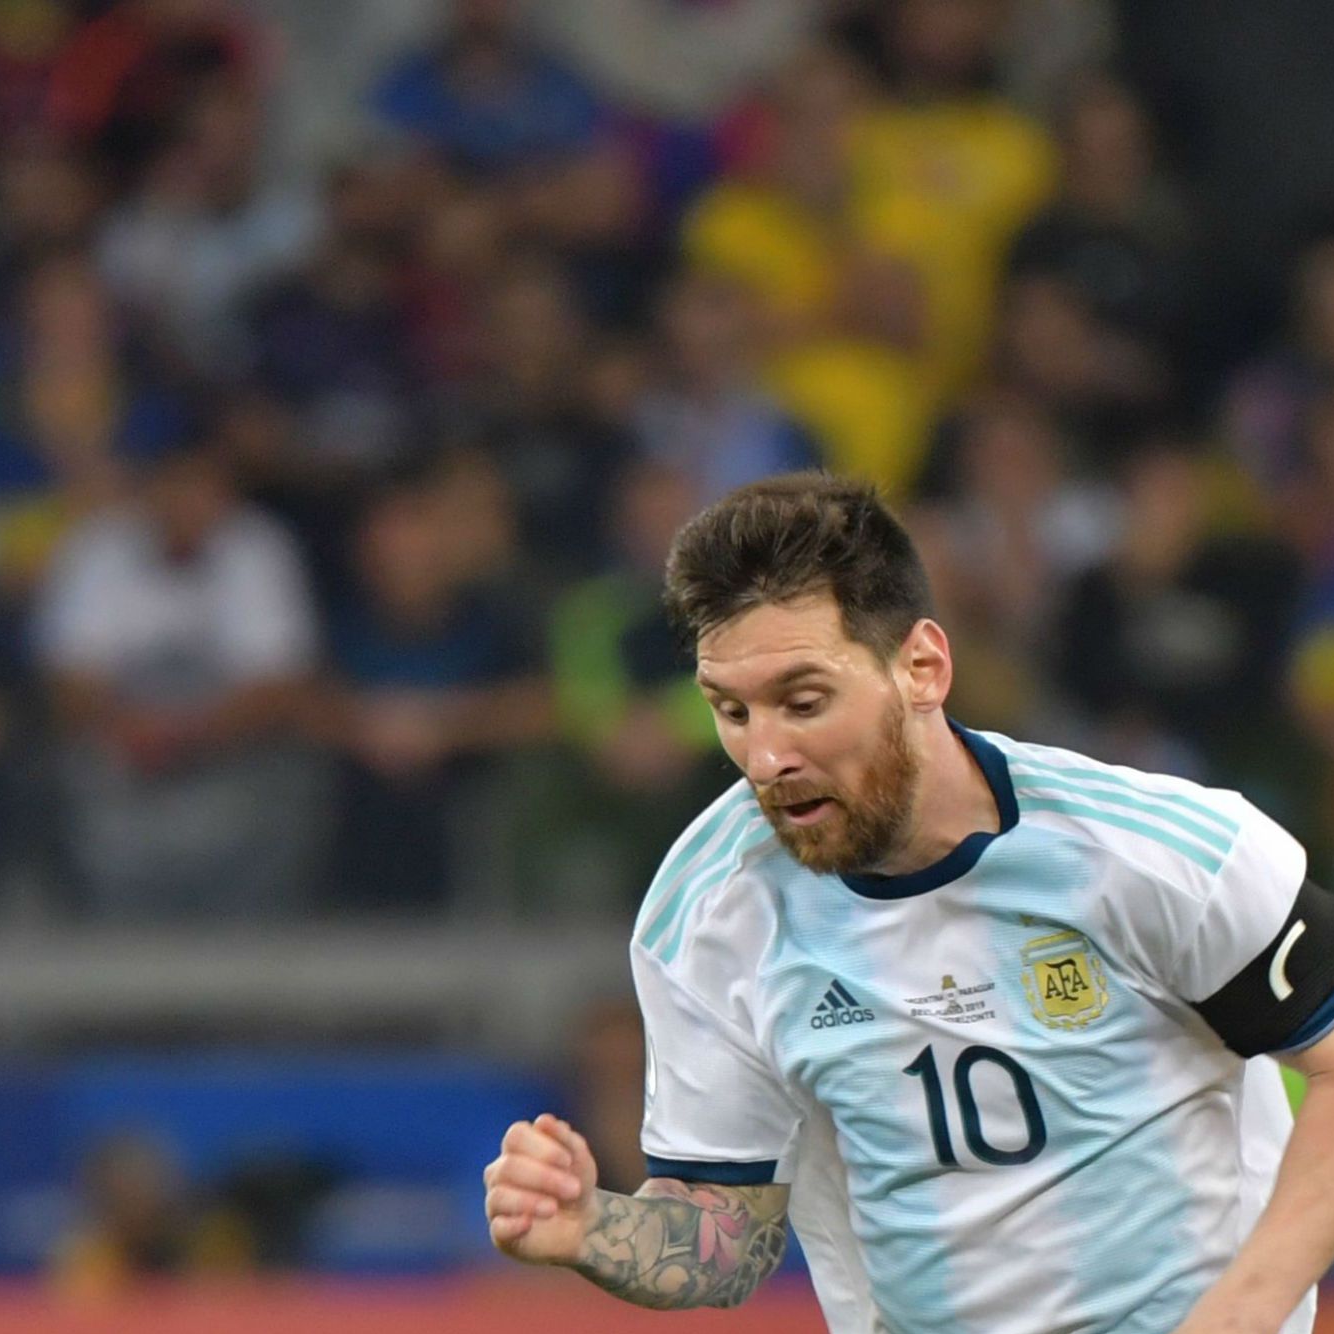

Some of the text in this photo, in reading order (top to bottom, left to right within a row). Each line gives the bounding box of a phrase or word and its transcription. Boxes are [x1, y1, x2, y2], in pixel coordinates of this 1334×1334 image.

[1045, 957, 1089, 1001] AFA
[810, 1008, 876, 1030] adidas
[902, 1042, 1048, 1167] 10
